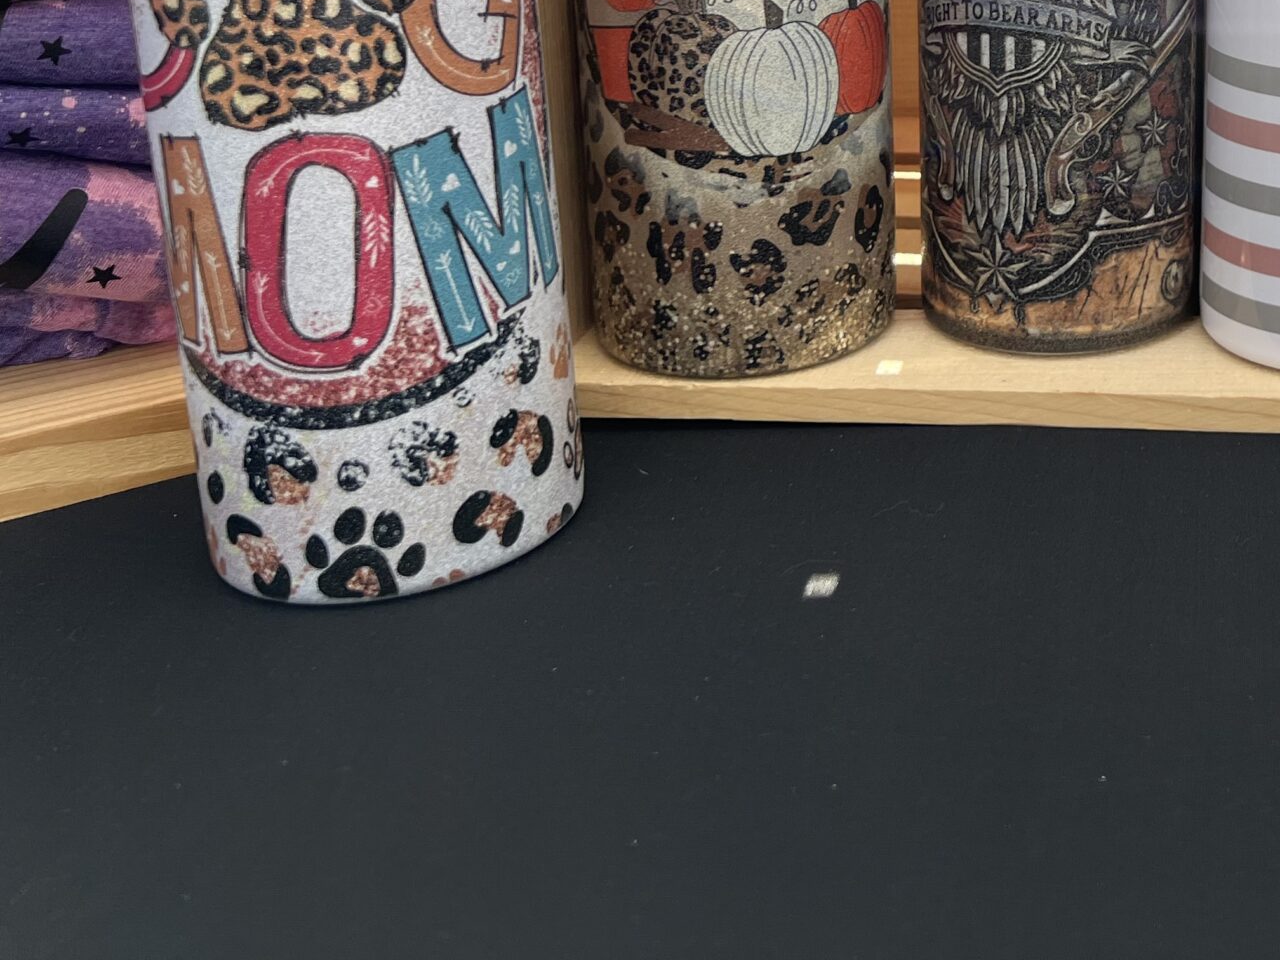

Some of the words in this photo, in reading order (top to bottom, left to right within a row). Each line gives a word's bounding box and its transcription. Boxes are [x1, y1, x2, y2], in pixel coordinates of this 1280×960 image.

[961, 0, 984, 20] TO
[989, 0, 1040, 27] BEAR
[1045, 11, 1107, 41] ARMS
